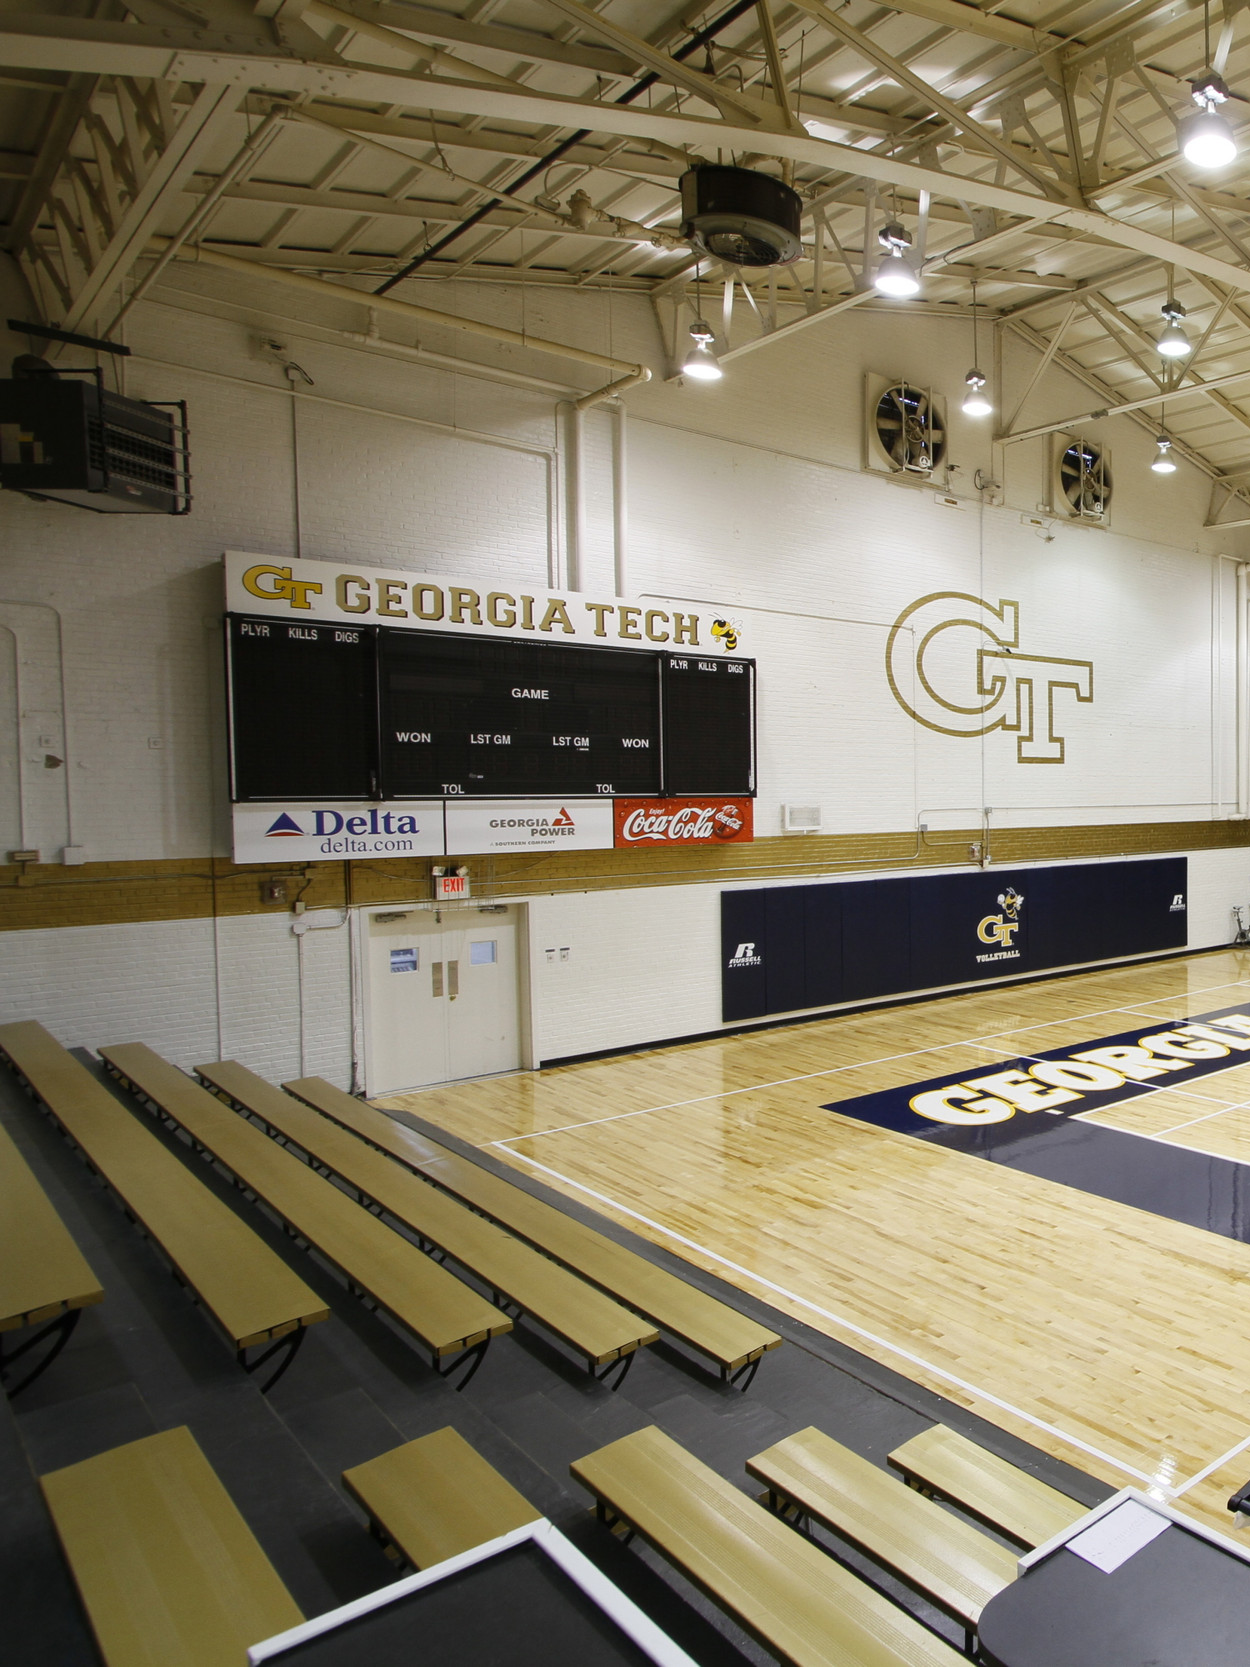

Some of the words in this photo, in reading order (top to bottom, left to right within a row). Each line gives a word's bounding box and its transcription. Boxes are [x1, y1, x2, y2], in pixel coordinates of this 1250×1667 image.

[242, 564, 323, 610] GT
[335, 573, 575, 634] GEORGIA
[585, 602, 700, 646] TECH
[241, 624, 270, 638] PLYR
[288, 627, 318, 641] KILLS
[335, 631, 359, 644] DIGS
[670, 659, 688, 670] PLYR
[698, 661, 717, 672] KILLS
[728, 663, 744, 674] DIGS
[885, 591, 1093, 764] GT
[511, 687, 549, 700] GAME
[396, 732, 431, 743] WON
[470, 734, 491, 745] LST
[493, 734, 511, 745] GM
[552, 736, 572, 746] LST
[573, 737, 590, 747] GM
[622, 738, 649, 748] WON
[441, 784, 465, 794] TOL
[596, 784, 616, 794] TOL
[312, 808, 420, 837] Delta
[489, 818, 549, 829] GEORGIA
[622, 807, 717, 841] Coca-Cola
[530, 827, 576, 837] POWER
[320, 837, 413, 854] delta.com
[443, 877, 465, 893] EXIT
[977, 914, 1019, 947] GT
[729, 956, 761, 965] RUSSELL
[976, 949, 1020, 963] VOLLEYBALL
